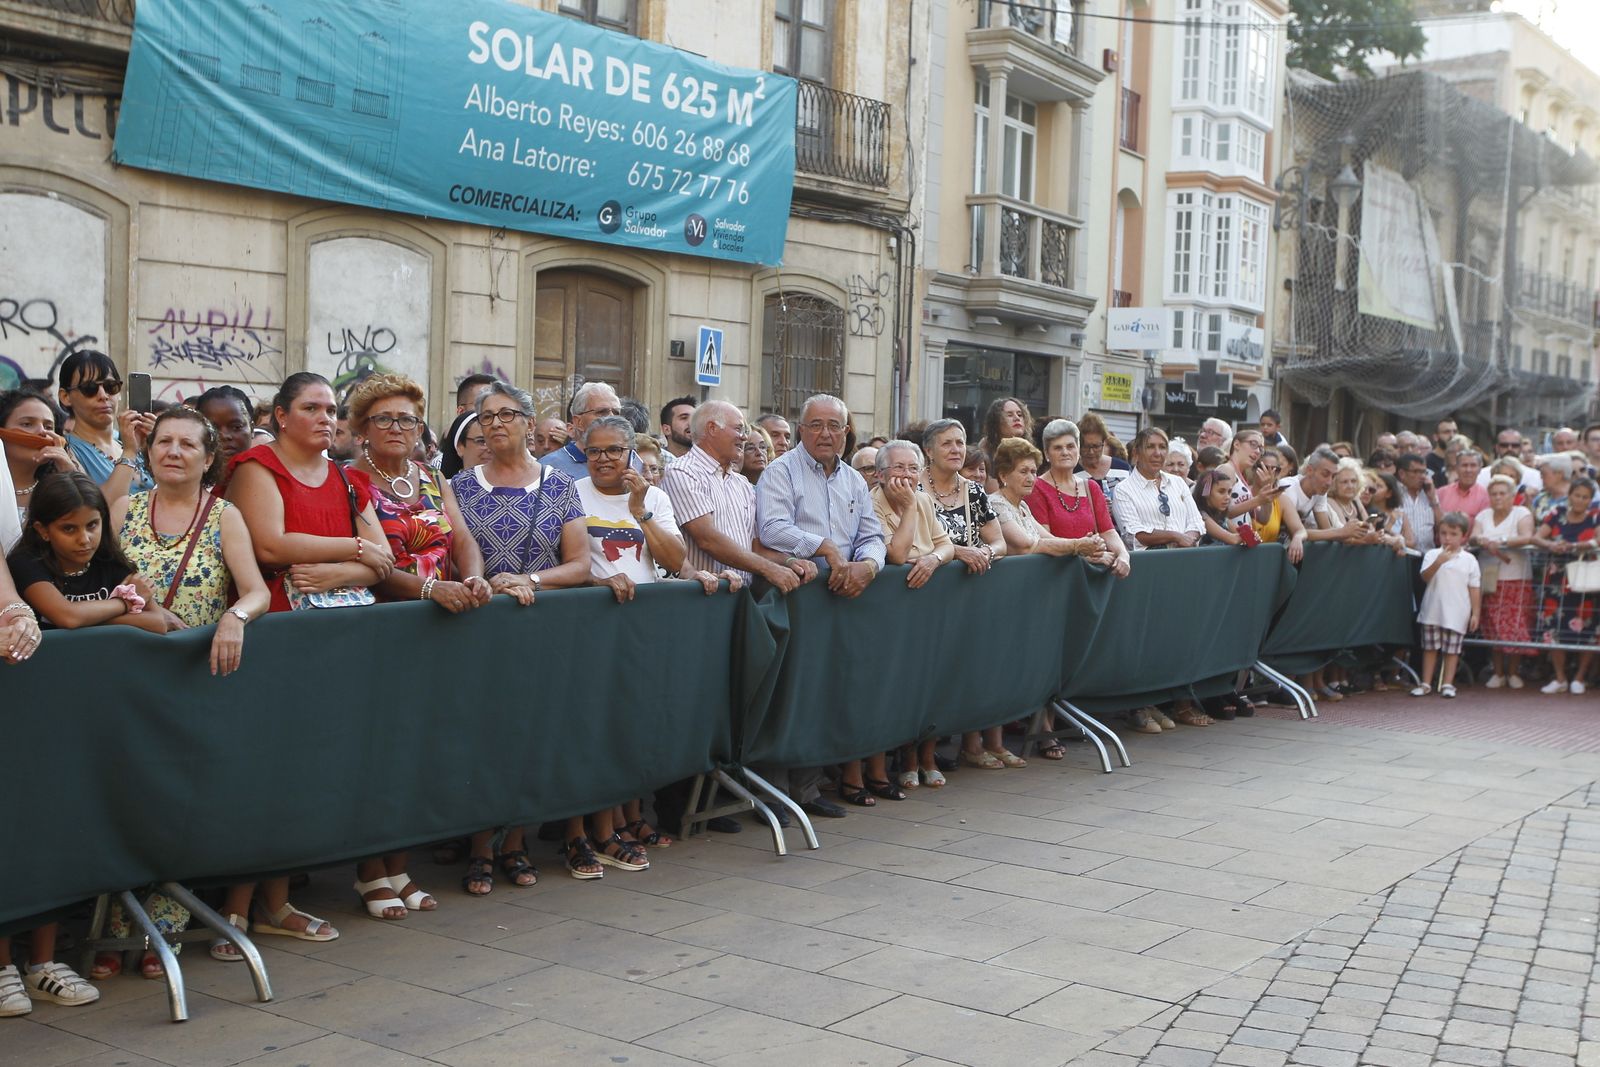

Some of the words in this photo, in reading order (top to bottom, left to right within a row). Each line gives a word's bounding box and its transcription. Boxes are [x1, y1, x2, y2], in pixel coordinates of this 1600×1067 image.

[467, 20, 594, 90] SOLAR
[605, 56, 651, 104] DE
[662, 72, 718, 119] 625
[464, 82, 551, 127] Alberto
[559, 103, 626, 143] Reyes:
[631, 121, 668, 152] 606
[674, 130, 697, 158] 26
[703, 138, 724, 163] 88
[727, 142, 751, 168] 68
[459, 127, 505, 162] Ana
[512, 139, 597, 179] Latorre:
[628, 161, 665, 191] 675
[669, 168, 692, 197] 72
[698, 173, 721, 201] 77
[726, 179, 750, 206] 76
[449, 183, 582, 223] COMERCIALIZA:
[625, 205, 657, 225] Grupo
[714, 217, 747, 233] Salvador
[624, 219, 668, 239] Salvador
[687, 218, 705, 239] SVL
[712, 228, 746, 243] Viviendas
[712, 239, 719, 249] &
[718, 240, 744, 253] Locales
[327, 324, 397, 355] UNO
